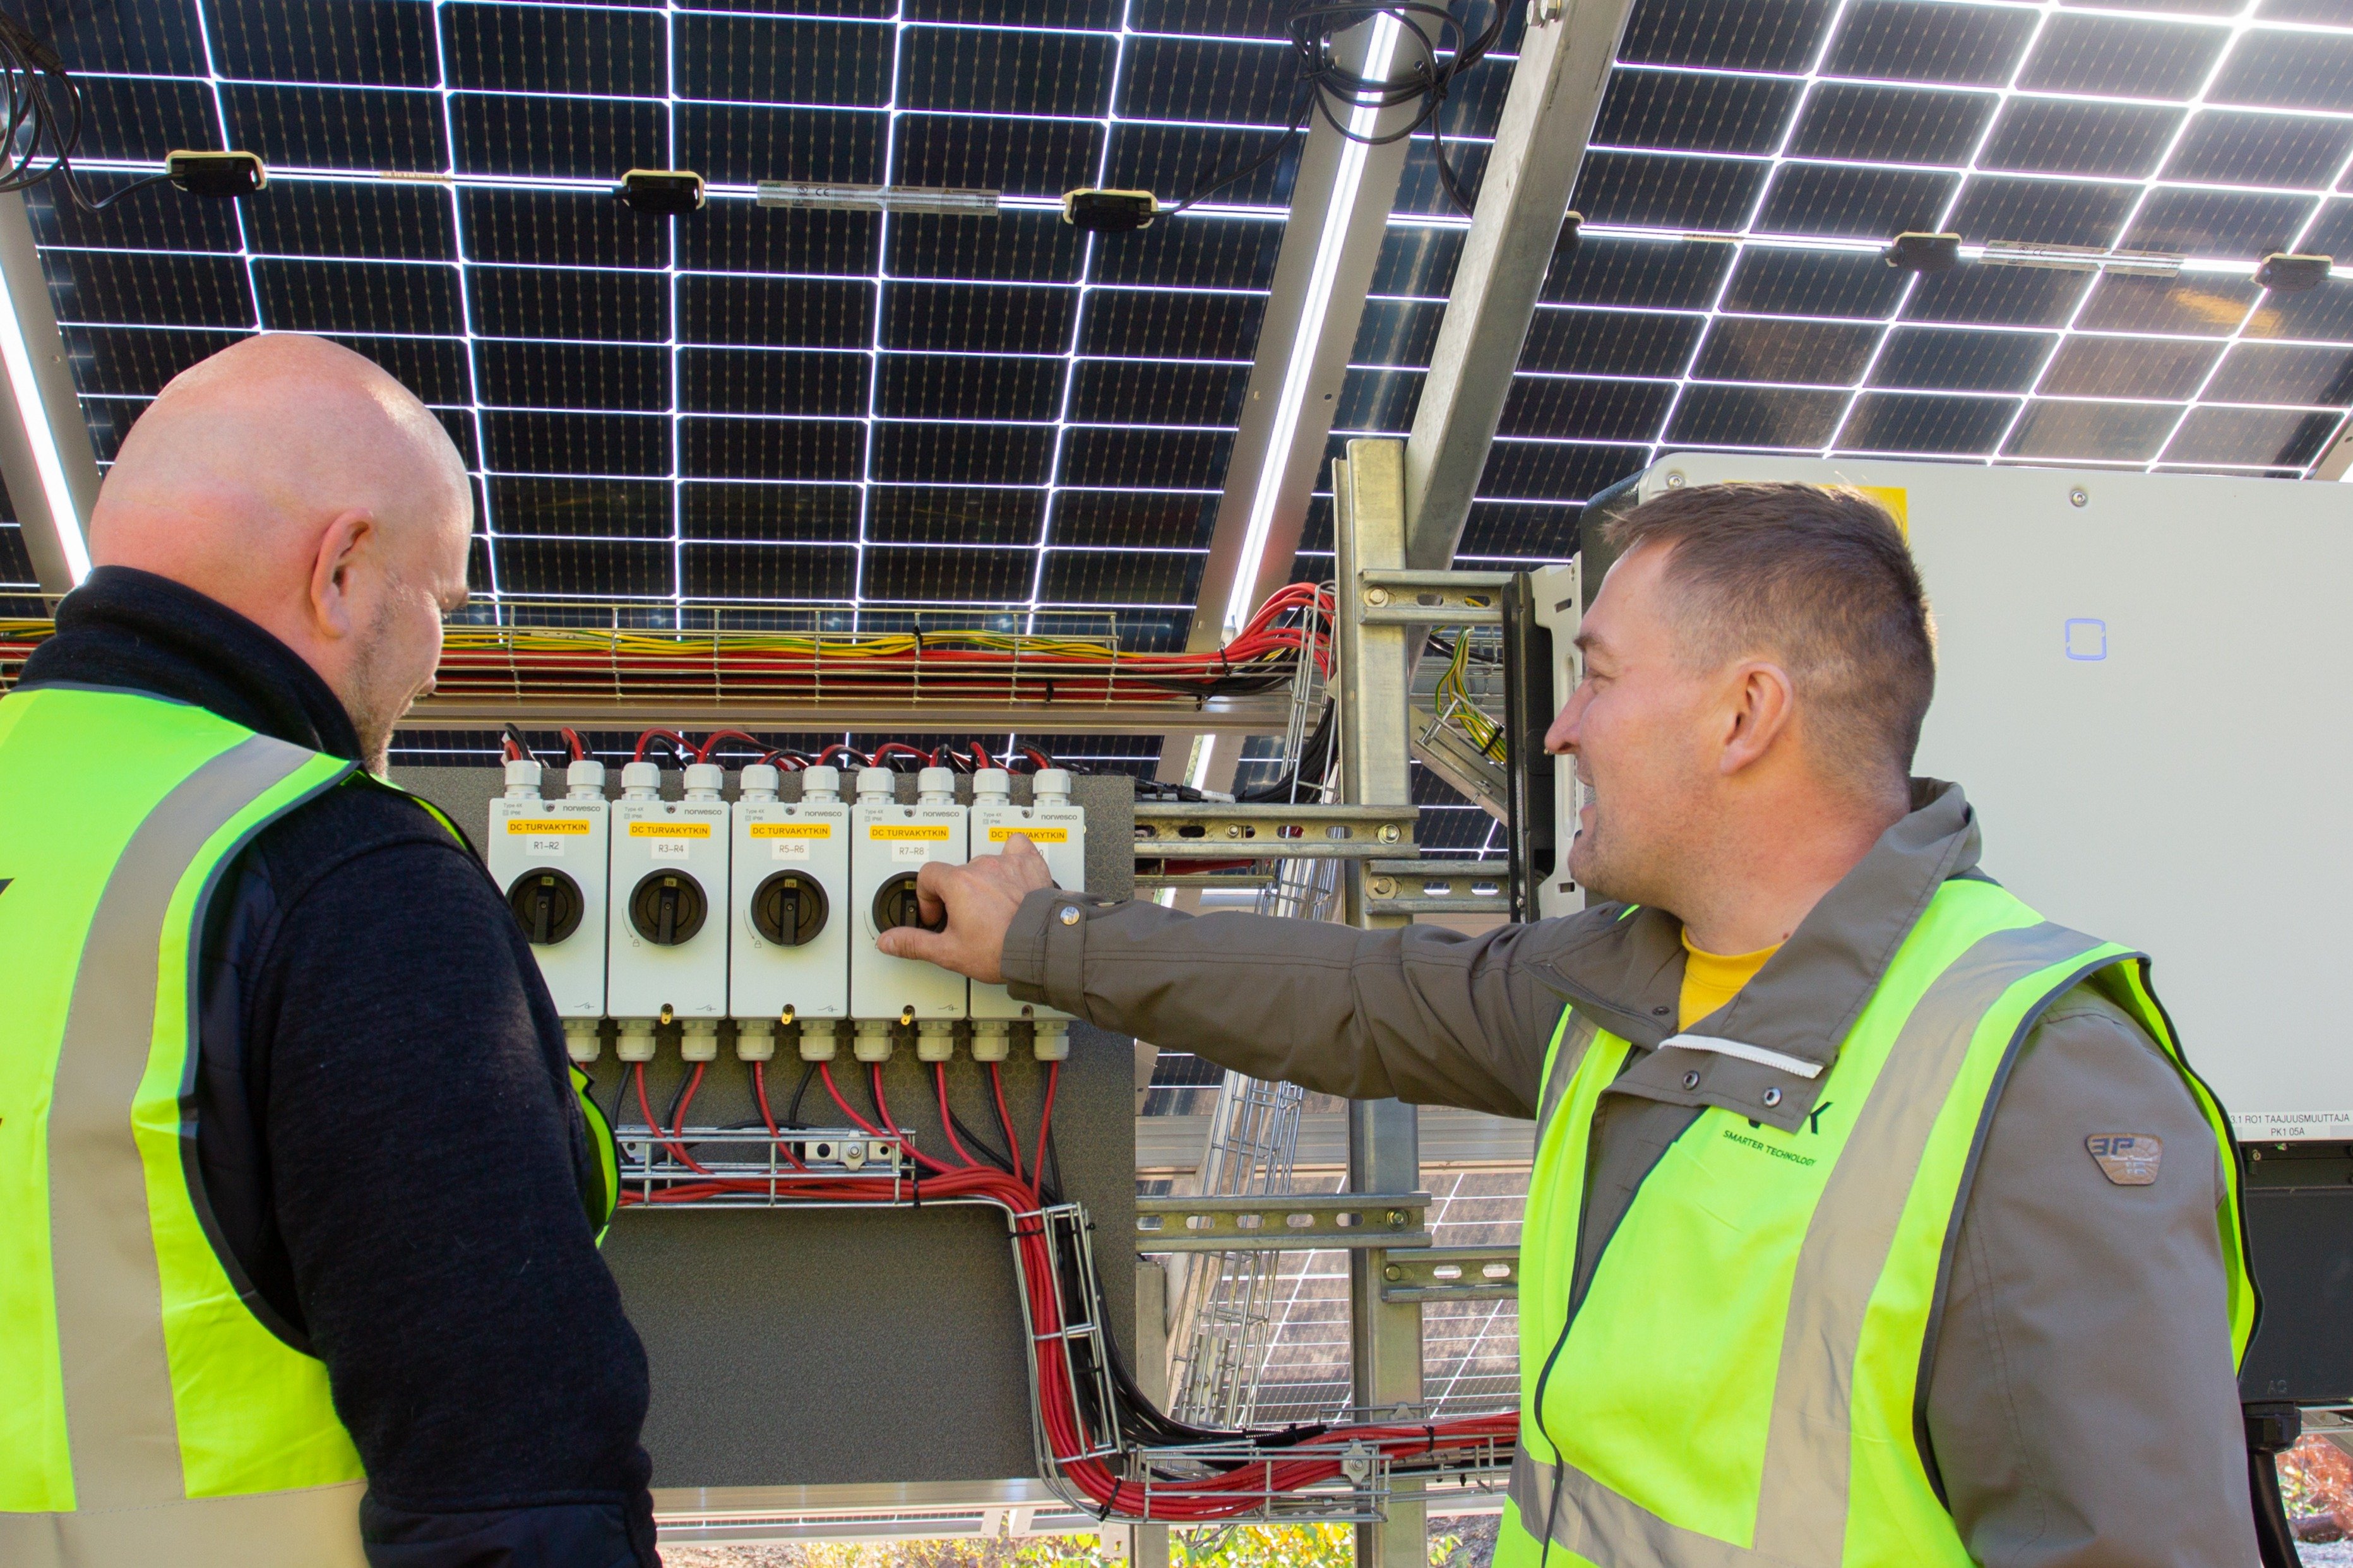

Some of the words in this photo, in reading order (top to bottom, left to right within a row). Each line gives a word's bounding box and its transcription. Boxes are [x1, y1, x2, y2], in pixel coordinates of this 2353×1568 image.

[2265, 1114, 2349, 1124] TAAJUUSMUUTTAJA
[2271, 1128, 2286, 1136] PK1
[2289, 1127, 2304, 1136] 05A
[1723, 1130, 1764, 1150] SMARTER
[1766, 1145, 1816, 1166] TECHNOLOGY
